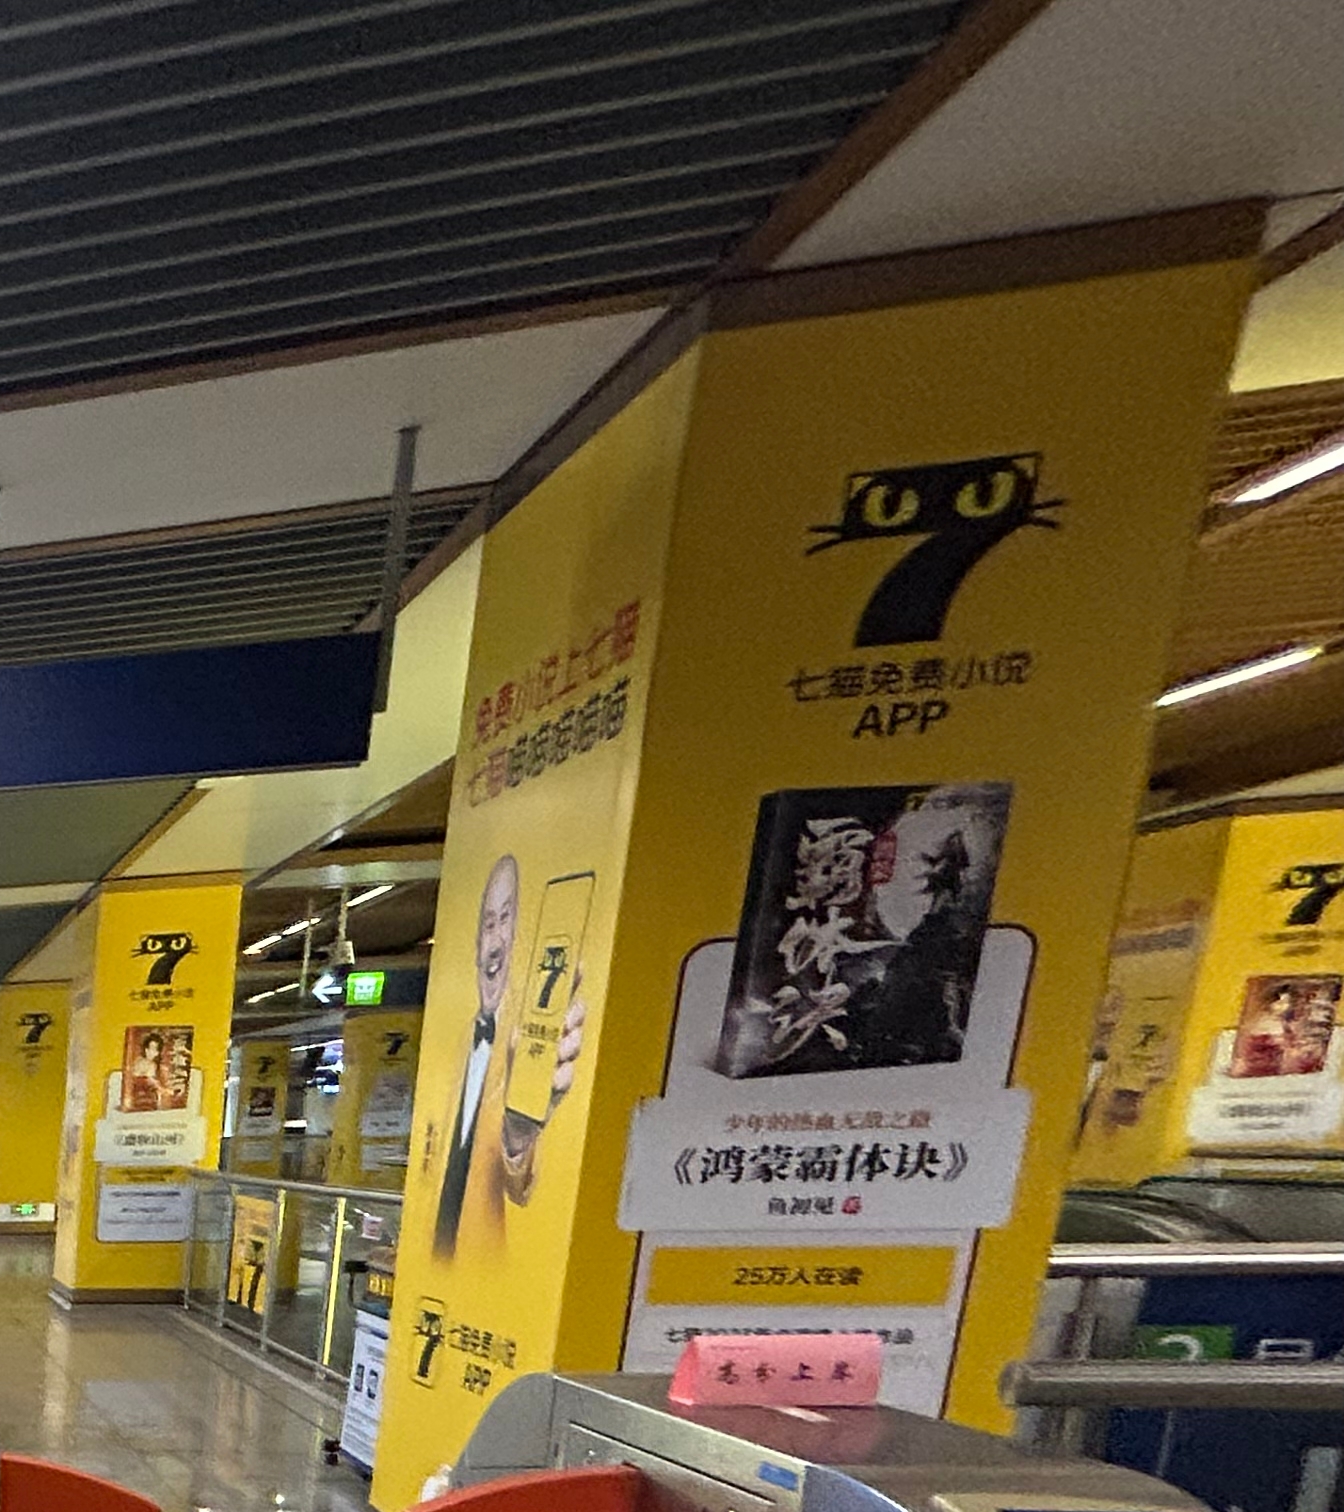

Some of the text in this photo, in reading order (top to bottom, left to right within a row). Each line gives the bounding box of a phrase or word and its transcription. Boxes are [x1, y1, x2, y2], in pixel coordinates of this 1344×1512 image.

[786, 651, 1033, 702] 七猫免费小说
[852, 699, 949, 739] APP
[733, 1265, 864, 1287] 25万人在读
